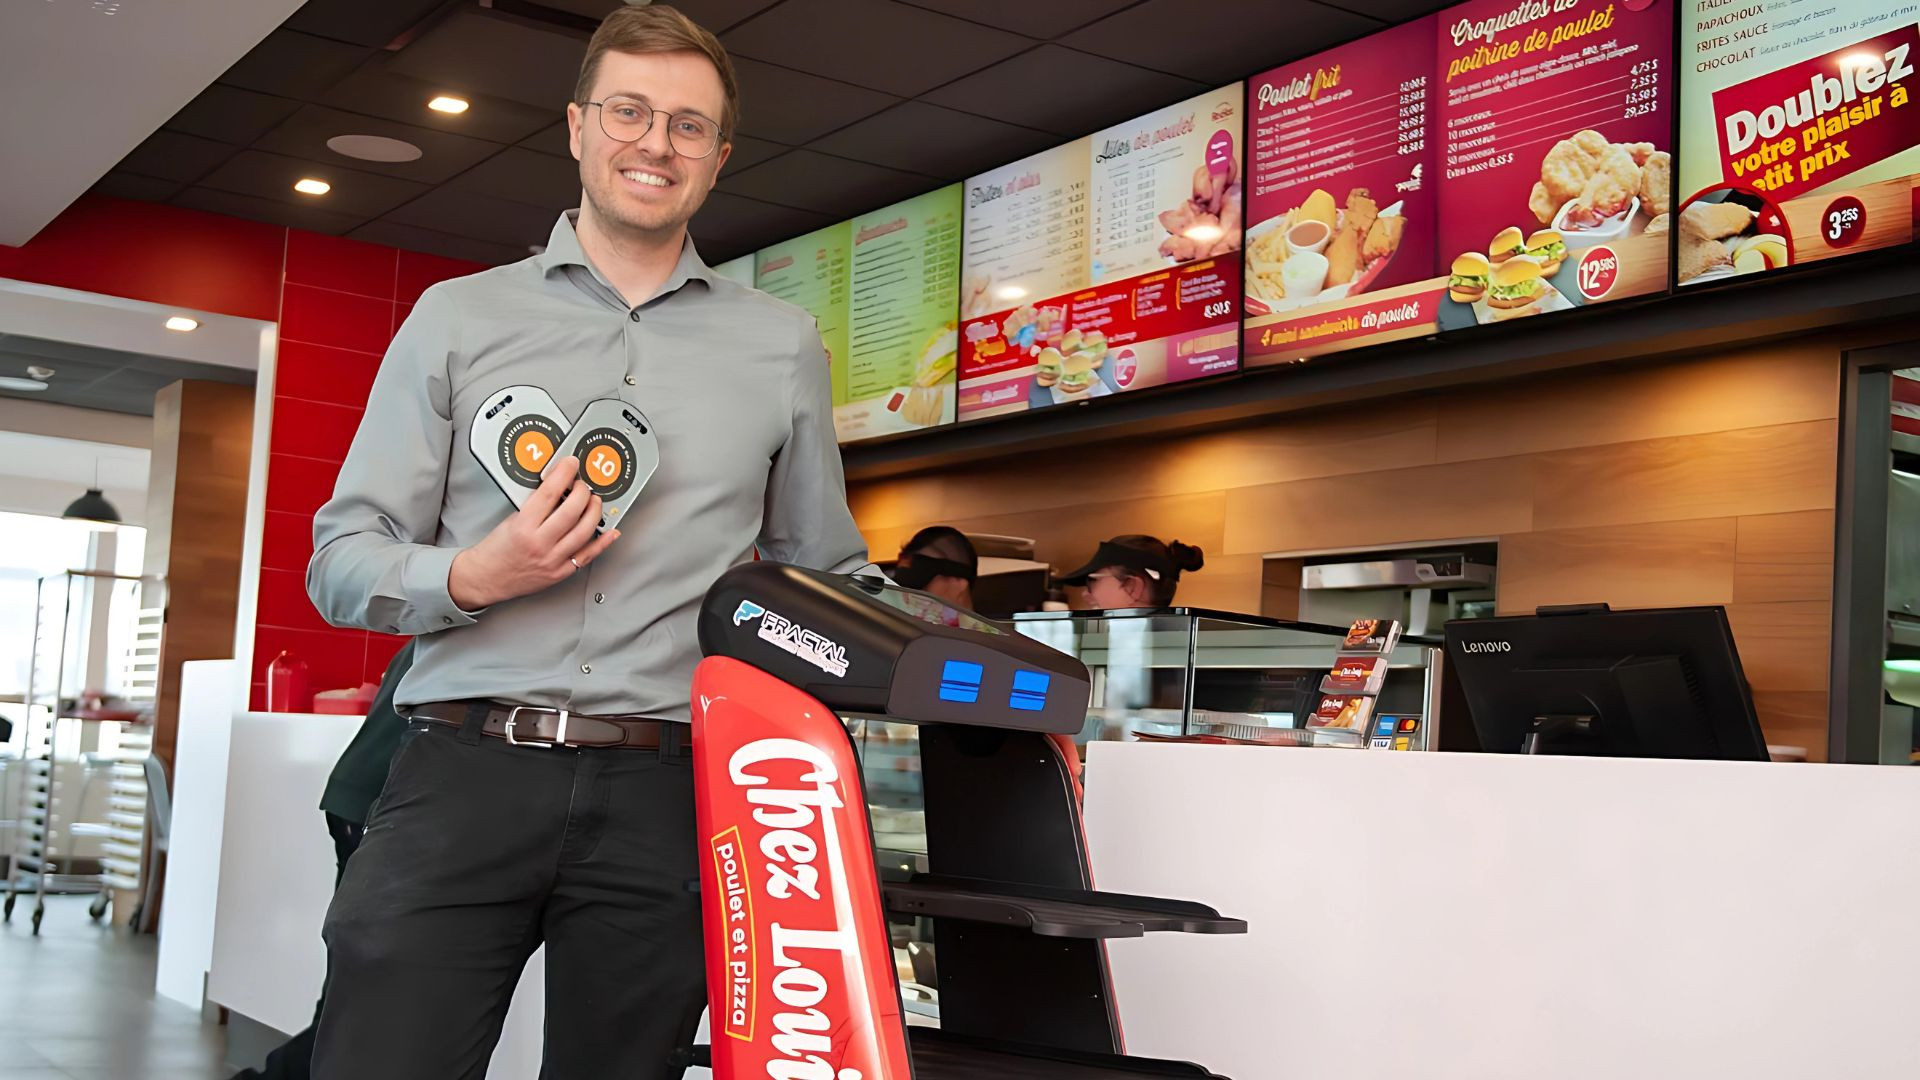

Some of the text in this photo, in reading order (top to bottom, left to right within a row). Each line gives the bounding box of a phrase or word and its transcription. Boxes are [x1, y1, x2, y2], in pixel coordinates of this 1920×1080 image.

[1451, 0, 1551, 46] Croquettes
[1697, 4, 1764, 32] PAPACHOUX
[1734, 23, 1768, 42] SAUCE
[1446, 3, 1614, 83] poitrine de poulet
[1697, 47, 1757, 73] CHOCOLAT
[1257, 72, 1312, 110] Poulet
[1309, 63, 1341, 100] frit
[1725, 43, 1914, 155] Doublez
[1732, 83, 1909, 177] votre plaisir à
[1752, 141, 1851, 191] etit prix
[1580, 260, 1600, 290] 12
[525, 443, 544, 462] 2
[592, 452, 616, 477] 10
[762, 612, 849, 667] FRACTAL
[1462, 640, 1511, 653] Lenovo
[728, 738, 845, 900] Chez
[716, 842, 751, 1026] poulet et pizza
